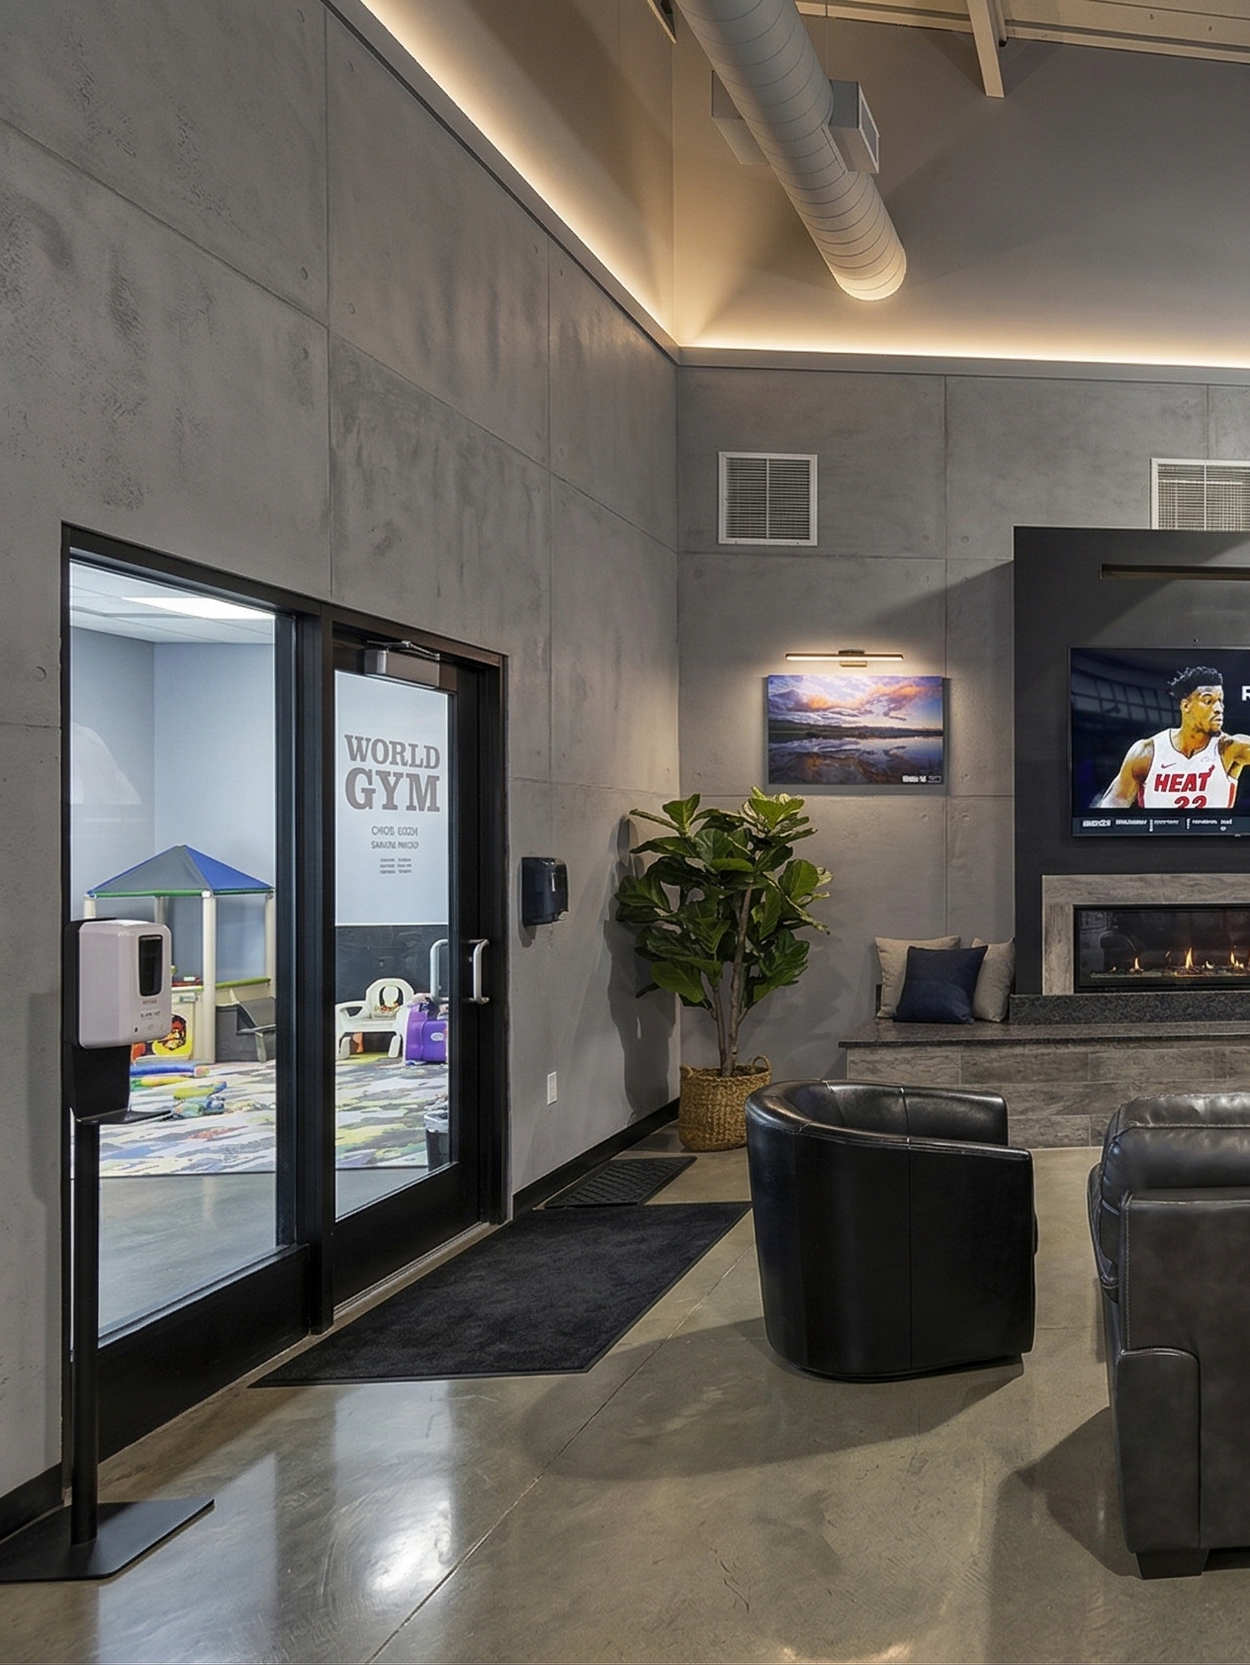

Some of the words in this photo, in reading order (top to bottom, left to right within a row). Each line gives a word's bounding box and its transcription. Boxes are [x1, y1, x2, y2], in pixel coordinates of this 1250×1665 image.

[344, 734, 440, 769] WORLD
[345, 767, 440, 812] GYM
[1154, 765, 1215, 793] HEAT
